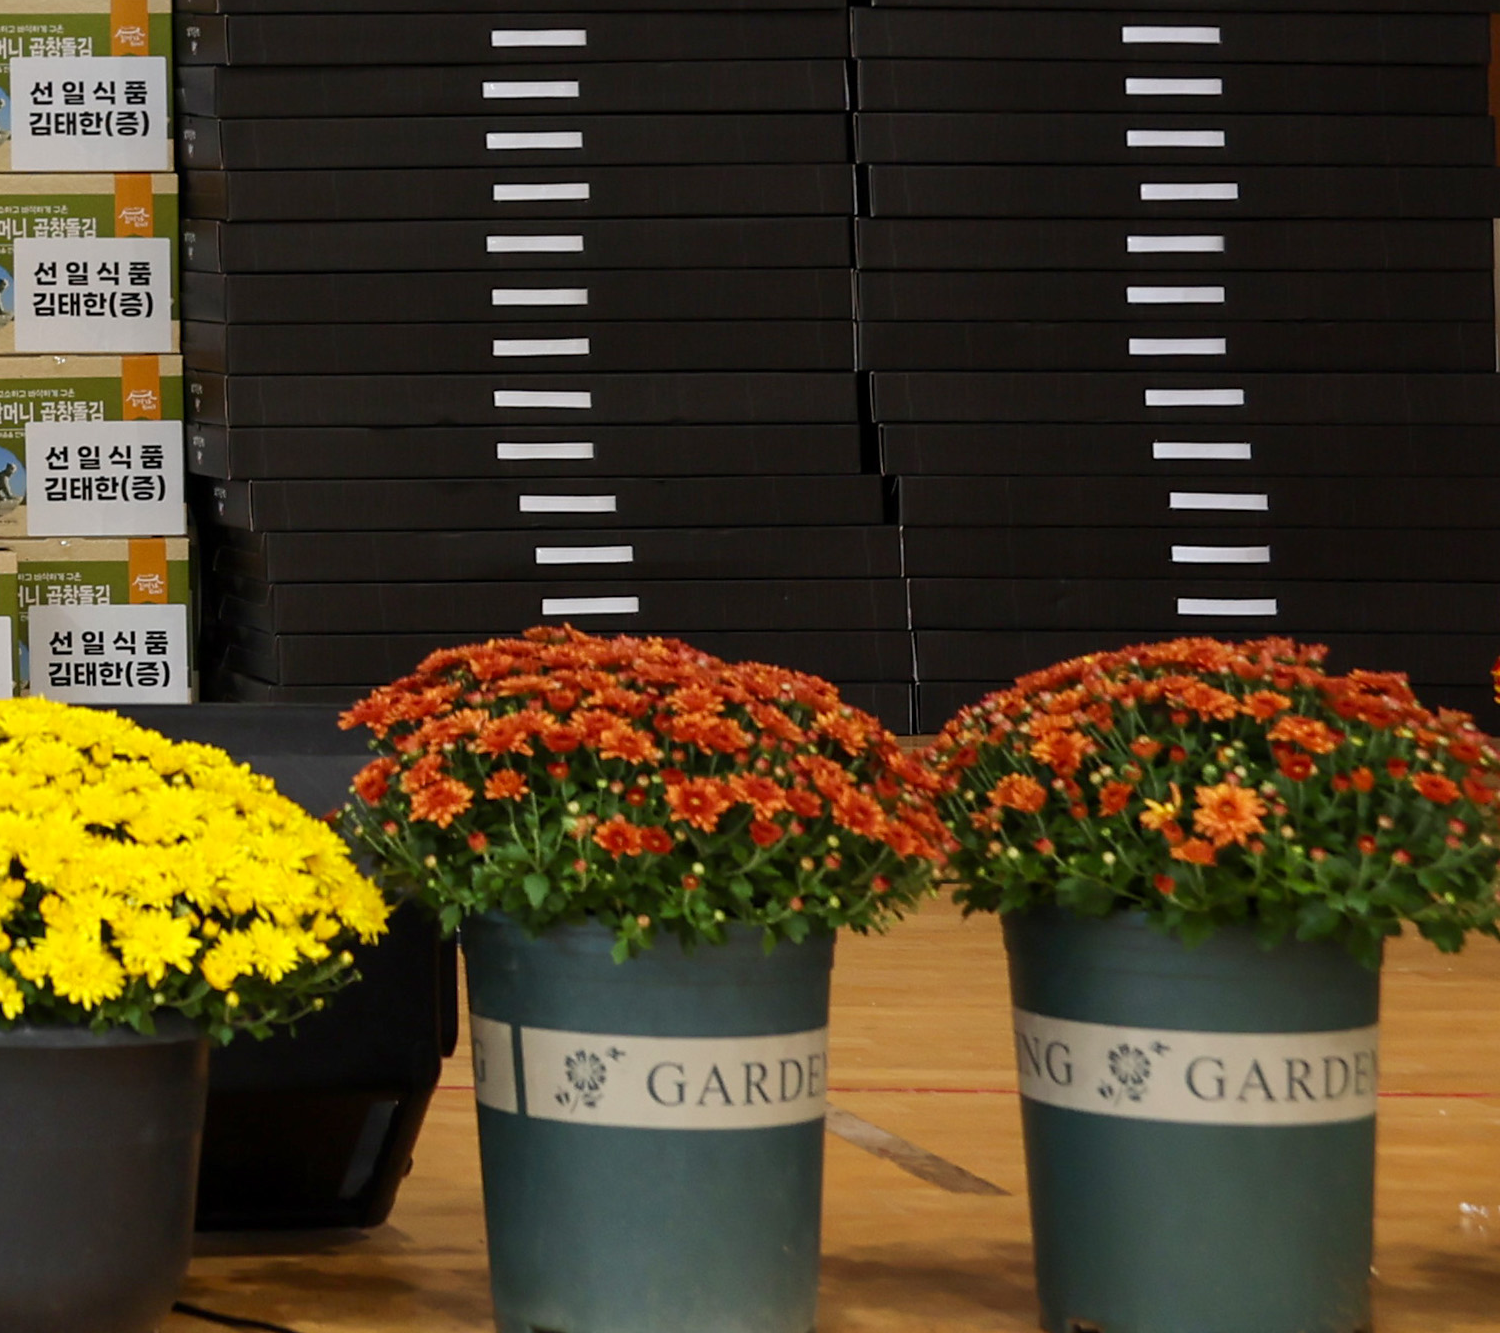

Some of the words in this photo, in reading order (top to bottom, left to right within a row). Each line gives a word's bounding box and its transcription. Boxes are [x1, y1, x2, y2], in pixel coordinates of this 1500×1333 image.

[30, 111, 149, 136] 김태한(증)
[33, 292, 153, 318] 김태한(증)
[45, 475, 165, 501] 김태한(증)
[49, 661, 170, 687] 김태한(증)
